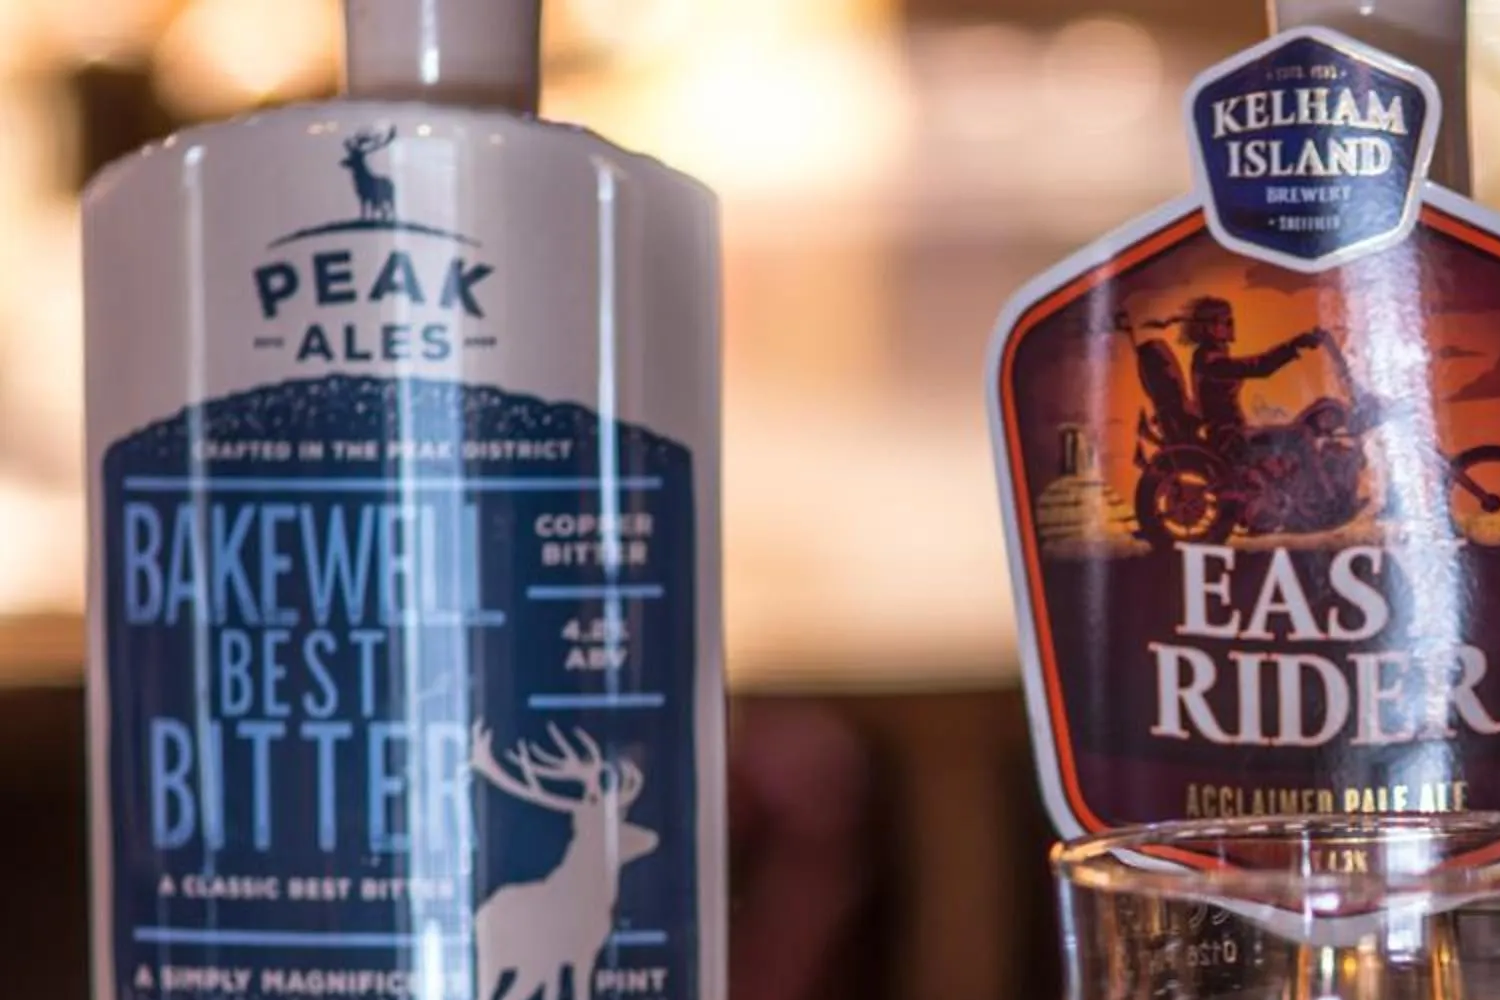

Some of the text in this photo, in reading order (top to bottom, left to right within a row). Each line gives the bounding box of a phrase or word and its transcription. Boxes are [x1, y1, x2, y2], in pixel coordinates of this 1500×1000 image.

[1213, 87, 1408, 139] KELHAM
[1227, 136, 1392, 177] ISLAND
[254, 249, 495, 320] PEAK
[296, 324, 451, 362] ALES
[297, 439, 324, 461] IN
[332, 439, 380, 462] THE
[462, 439, 572, 462] DISTRICT
[125, 503, 504, 627] BAKEWELL
[219, 629, 385, 718] BEST
[150, 717, 478, 854] BITTER
[158, 874, 176, 897] A
[182, 874, 280, 900] CLASSIC
[288, 876, 352, 900] BEST
[135, 965, 668, 995] A SIMPLY MAGNIFIC PINT
